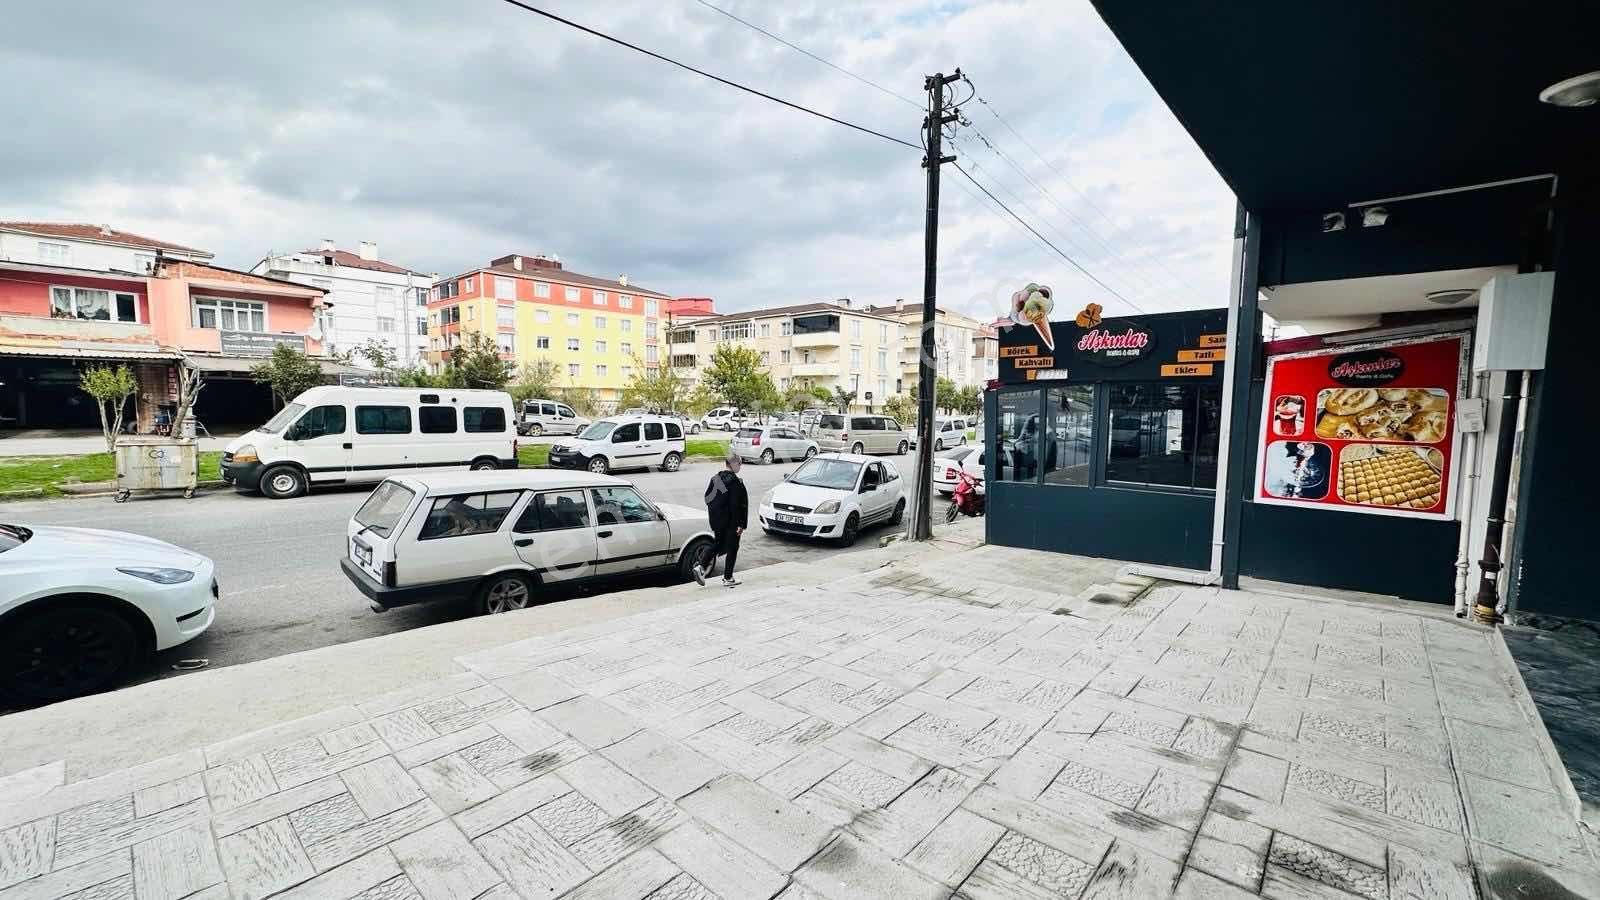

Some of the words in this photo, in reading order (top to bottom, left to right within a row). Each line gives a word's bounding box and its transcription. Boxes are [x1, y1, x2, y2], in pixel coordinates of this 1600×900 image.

[1207, 336, 1227, 345] San
[1194, 350, 1215, 360] Tatlı
[1018, 358, 1052, 368] Kahvaltı
[1174, 365, 1199, 375] Ekler
